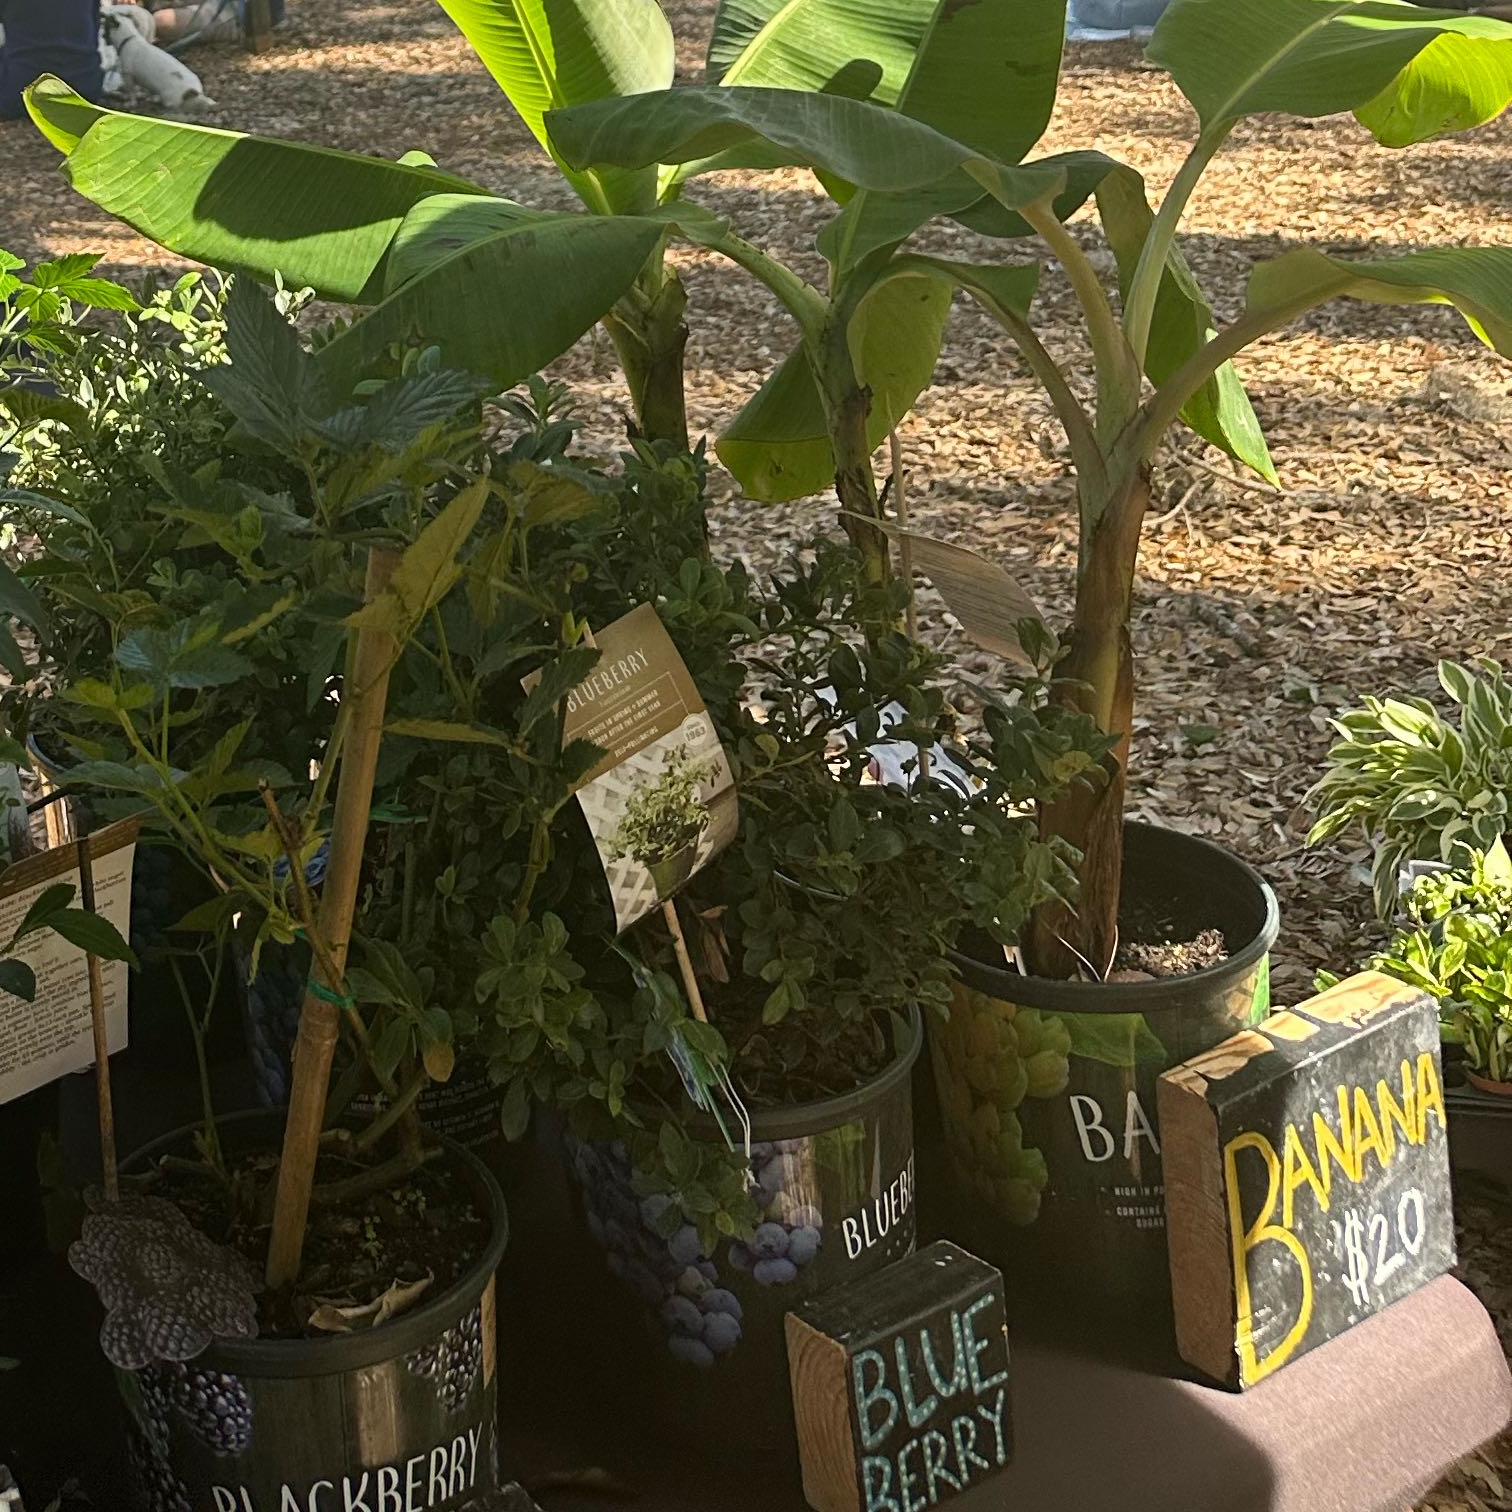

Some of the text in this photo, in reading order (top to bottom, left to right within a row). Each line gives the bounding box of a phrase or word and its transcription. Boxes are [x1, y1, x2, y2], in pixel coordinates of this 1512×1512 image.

[567, 647, 649, 713] BLUEBERRY
[842, 1147, 915, 1259] BLUEBE
[1224, 1052, 1447, 1388] BANANA
[1342, 1187, 1427, 1307] $20
[852, 1294, 1009, 1450] BLUE
[861, 1389, 1007, 1512] BERRY
